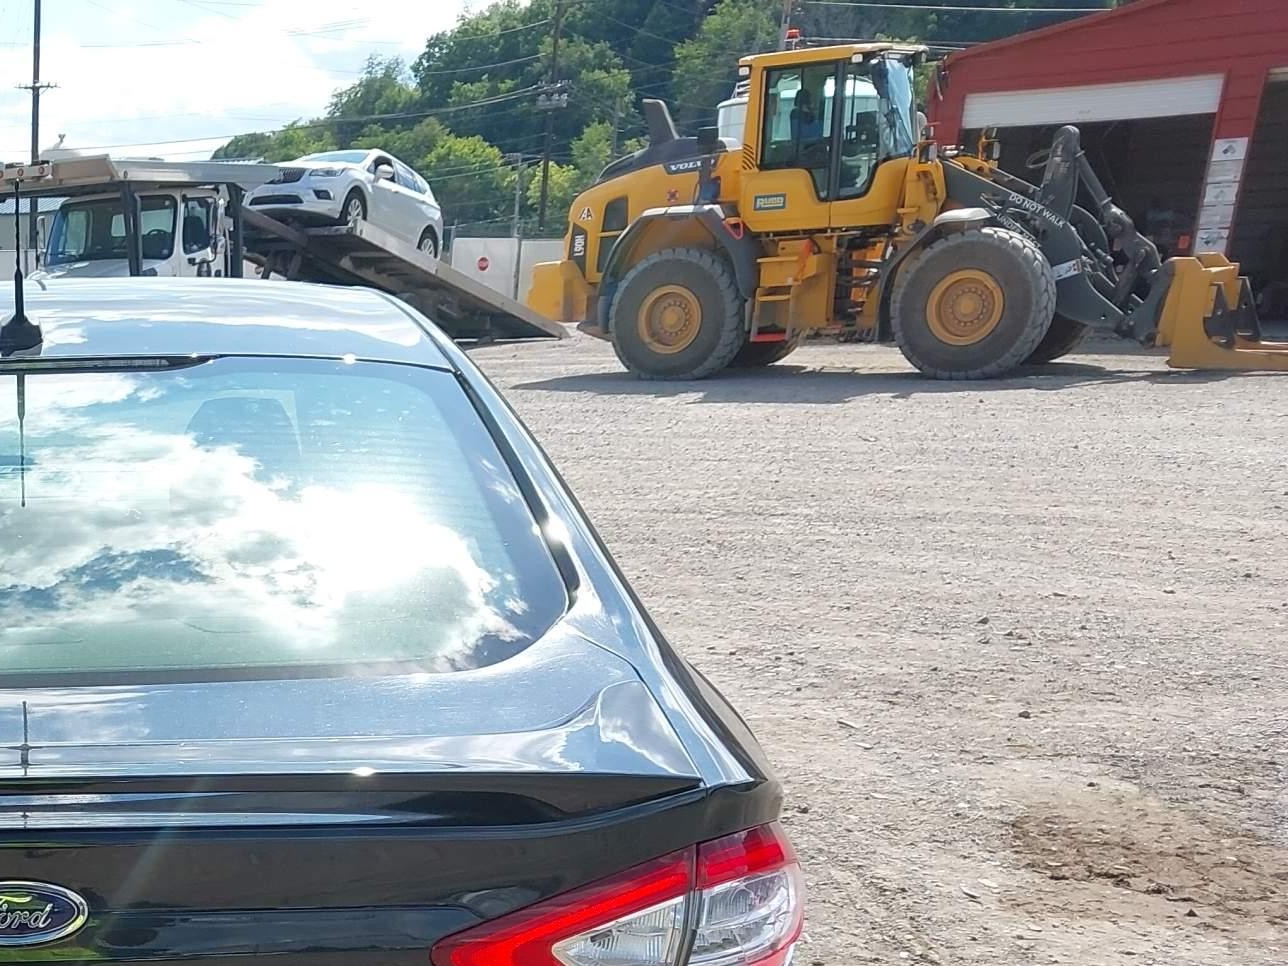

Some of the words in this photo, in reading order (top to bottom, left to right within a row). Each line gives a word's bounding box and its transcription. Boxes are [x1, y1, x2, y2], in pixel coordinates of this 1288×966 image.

[669, 159, 716, 171] VOLV
[1009, 193, 1023, 205] DO
[1023, 199, 1043, 214] NOT
[1042, 208, 1066, 228] WALK
[573, 234, 585, 257] L90H
